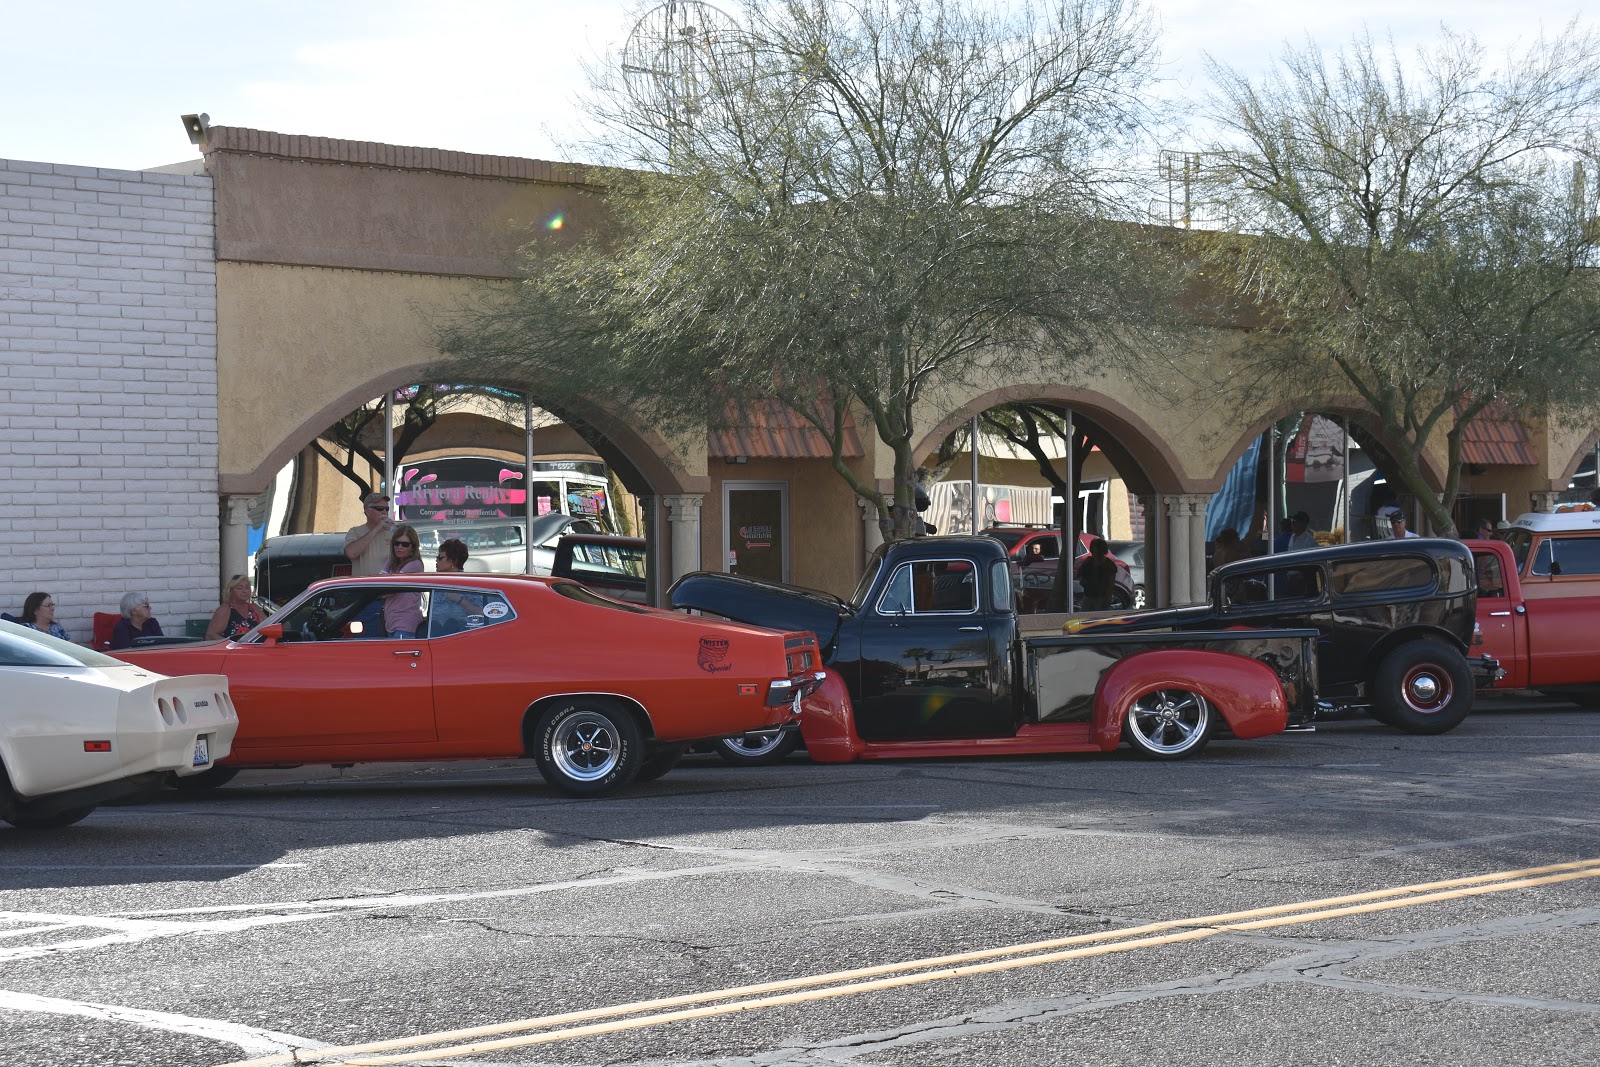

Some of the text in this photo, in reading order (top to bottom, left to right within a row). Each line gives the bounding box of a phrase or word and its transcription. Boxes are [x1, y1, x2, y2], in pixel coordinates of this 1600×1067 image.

[413, 484, 505, 502] Riviera Realty
[455, 508, 466, 516] and
[699, 638, 729, 646] TWISTER
[708, 664, 732, 674] Special
[551, 705, 575, 726] COBRA
[616, 739, 628, 771] RADIAL
